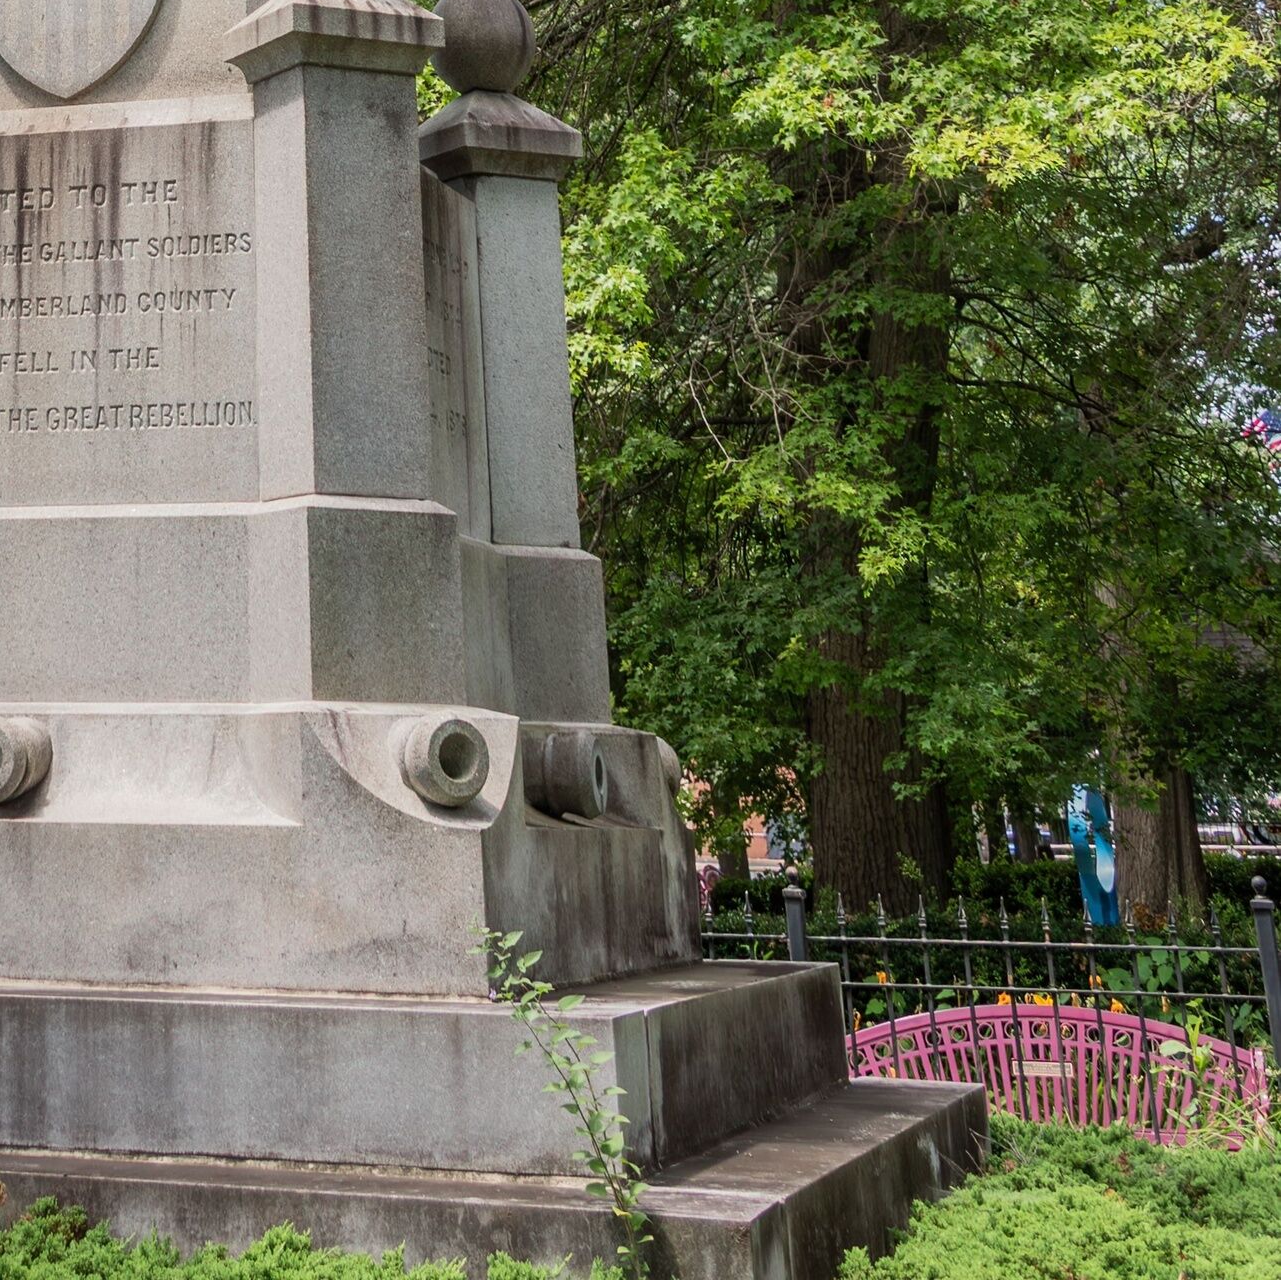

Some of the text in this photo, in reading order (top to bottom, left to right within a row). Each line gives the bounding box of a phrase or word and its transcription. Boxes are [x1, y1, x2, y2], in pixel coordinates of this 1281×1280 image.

[68, 183, 107, 209] TO
[120, 179, 179, 206] THE
[39, 238, 140, 263] GALLANT
[147, 232, 253, 259] SOLDIERS
[137, 287, 237, 314] COUNTY
[70, 349, 97, 372] IN
[109, 346, 161, 371] THE
[45, 404, 124, 432] GREAT
[128, 400, 259, 430] REBELLION.
